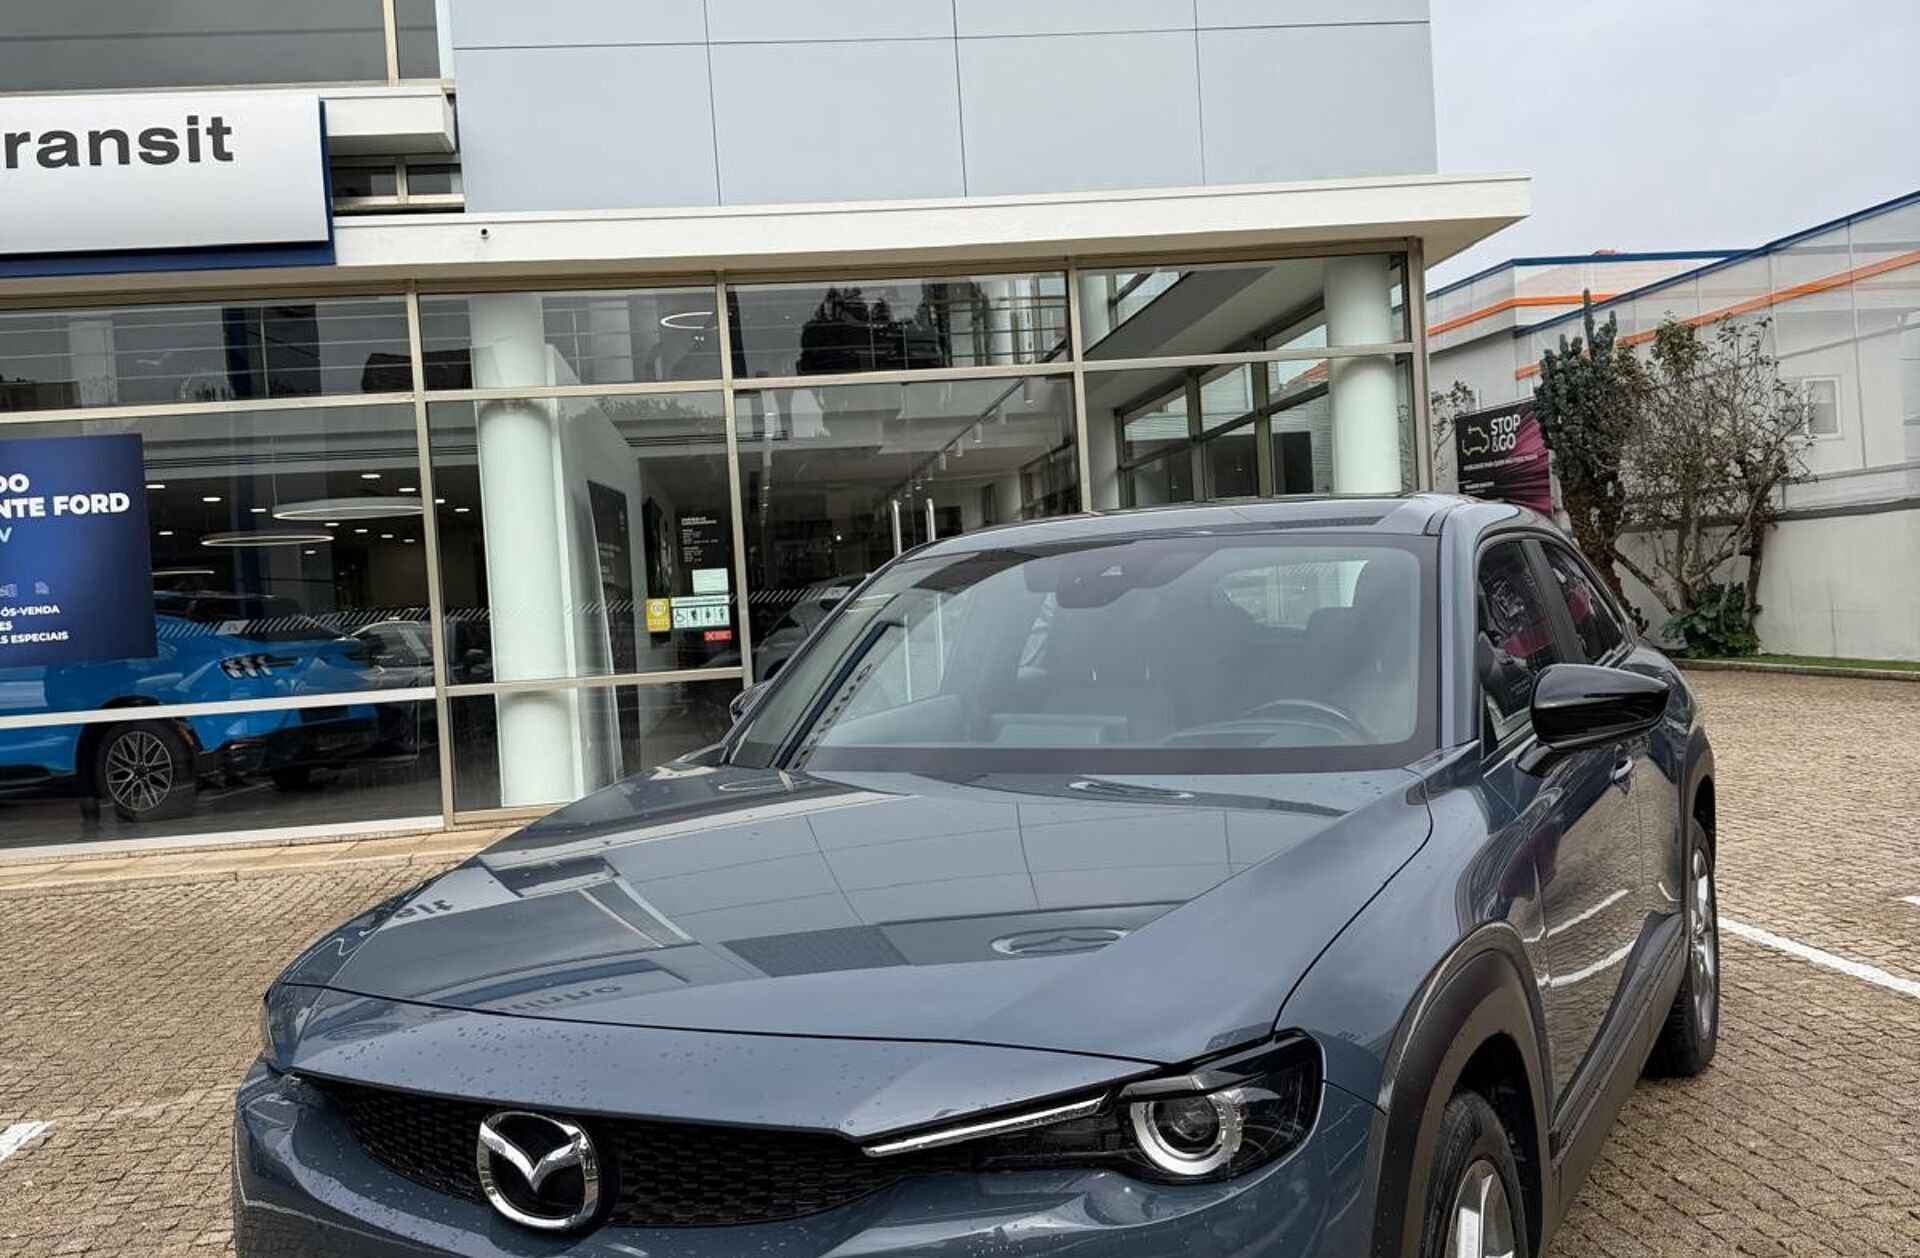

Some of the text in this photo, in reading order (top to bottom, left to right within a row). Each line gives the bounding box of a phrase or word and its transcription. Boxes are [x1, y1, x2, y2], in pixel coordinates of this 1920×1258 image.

[4, 115, 234, 169] ransit
[1491, 414, 1520, 435] STOP
[1491, 433, 1516, 453] &GO
[53, 492, 130, 516] FORD
[11, 631, 69, 644] ESPECIAIS
